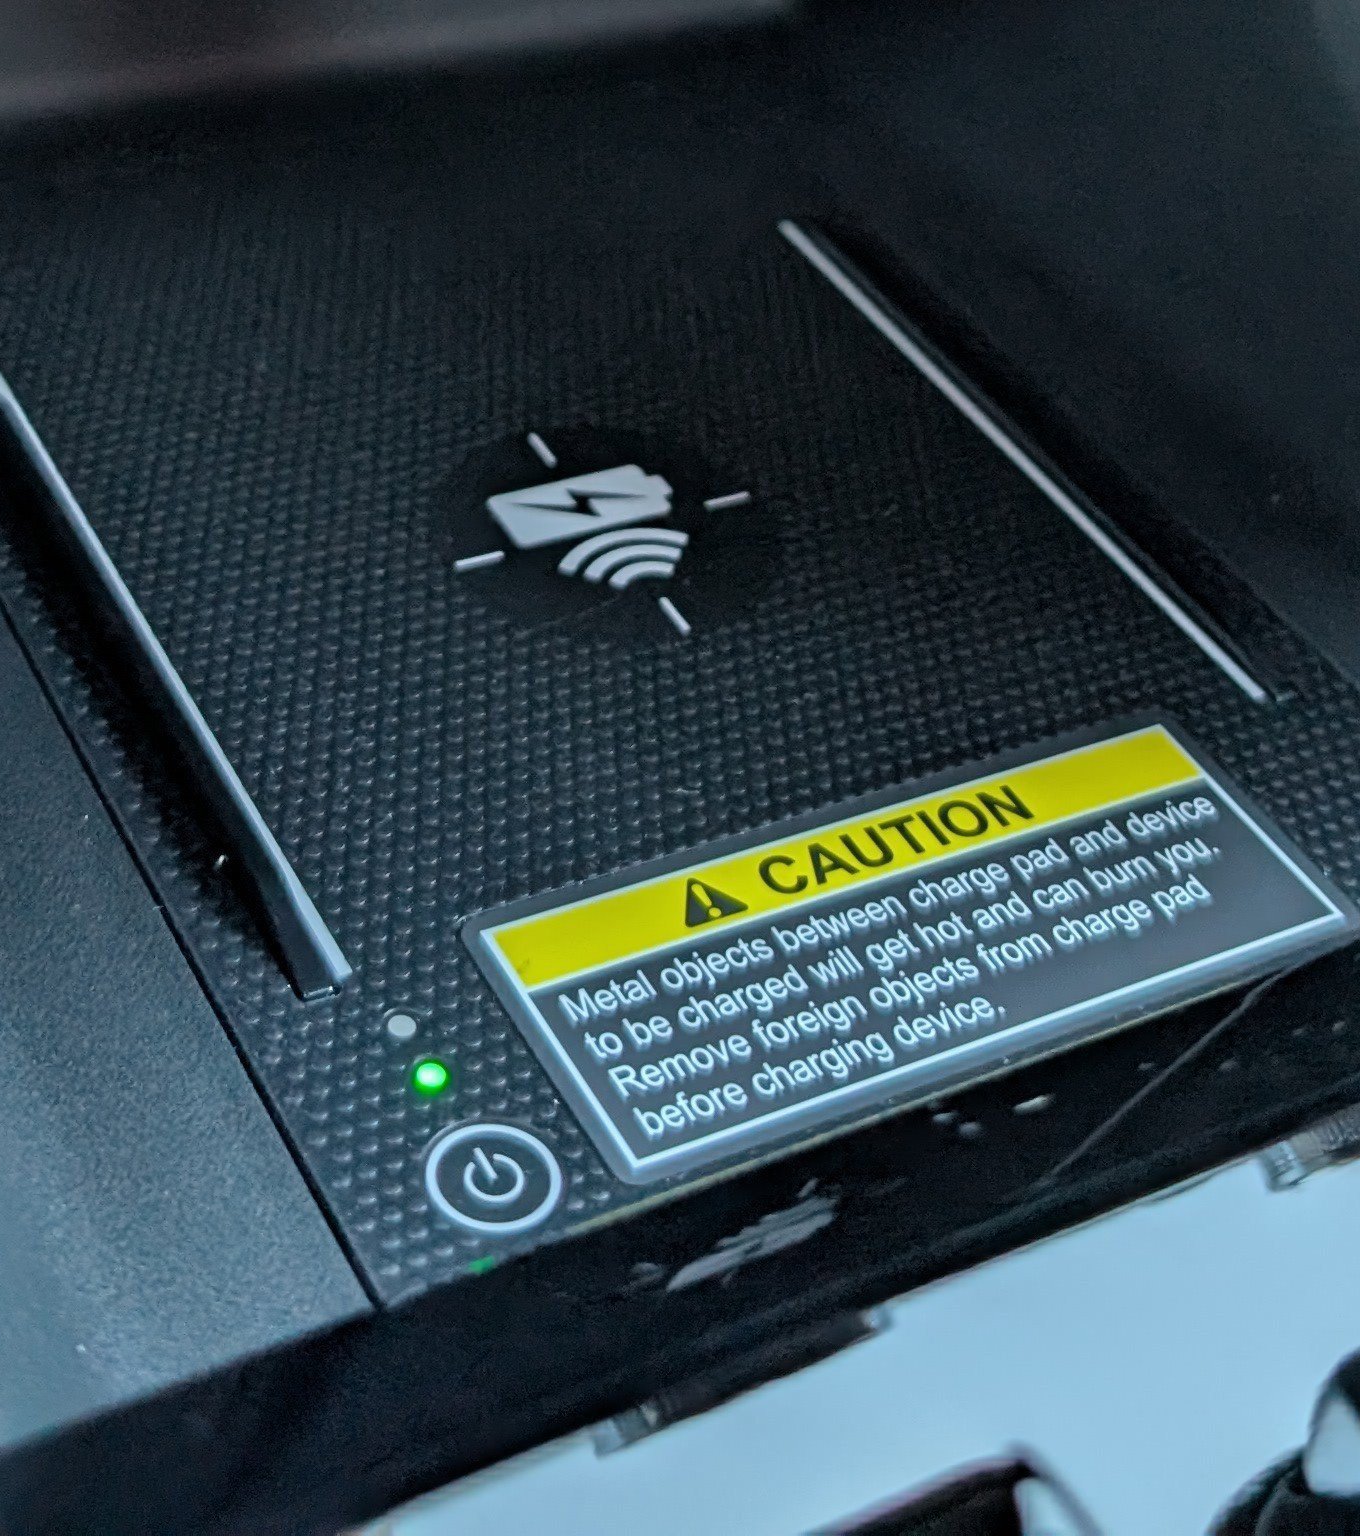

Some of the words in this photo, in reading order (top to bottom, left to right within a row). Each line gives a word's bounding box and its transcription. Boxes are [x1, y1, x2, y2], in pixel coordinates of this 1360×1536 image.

[558, 969, 657, 1023] Metal
[660, 936, 774, 990] objects
[771, 894, 908, 952] between
[909, 863, 1010, 907] charge
[1010, 838, 1069, 882] pad
[1070, 819, 1126, 858] and
[1126, 795, 1216, 838] device
[585, 1030, 623, 1060] to
[622, 1015, 673, 1047] be
[677, 964, 809, 1029] charged
[806, 946, 864, 986] will
[865, 929, 920, 971] get
[913, 911, 974, 948] hot
[972, 891, 1033, 930] and
[1032, 876, 1091, 910] can
[1083, 854, 1157, 891] burn
[1154, 836, 1220, 876] you.
[758, 784, 1035, 895] CAUTION
[608, 1033, 752, 1098] Remove
[751, 995, 868, 1049] foreign
[869, 956, 979, 1009] objects
[976, 930, 1053, 972] from
[1052, 897, 1152, 945] charge
[1151, 873, 1212, 920] pad
[633, 1080, 747, 1138] before
[751, 1030, 894, 1096] charging
[893, 995, 1006, 1046] device.
